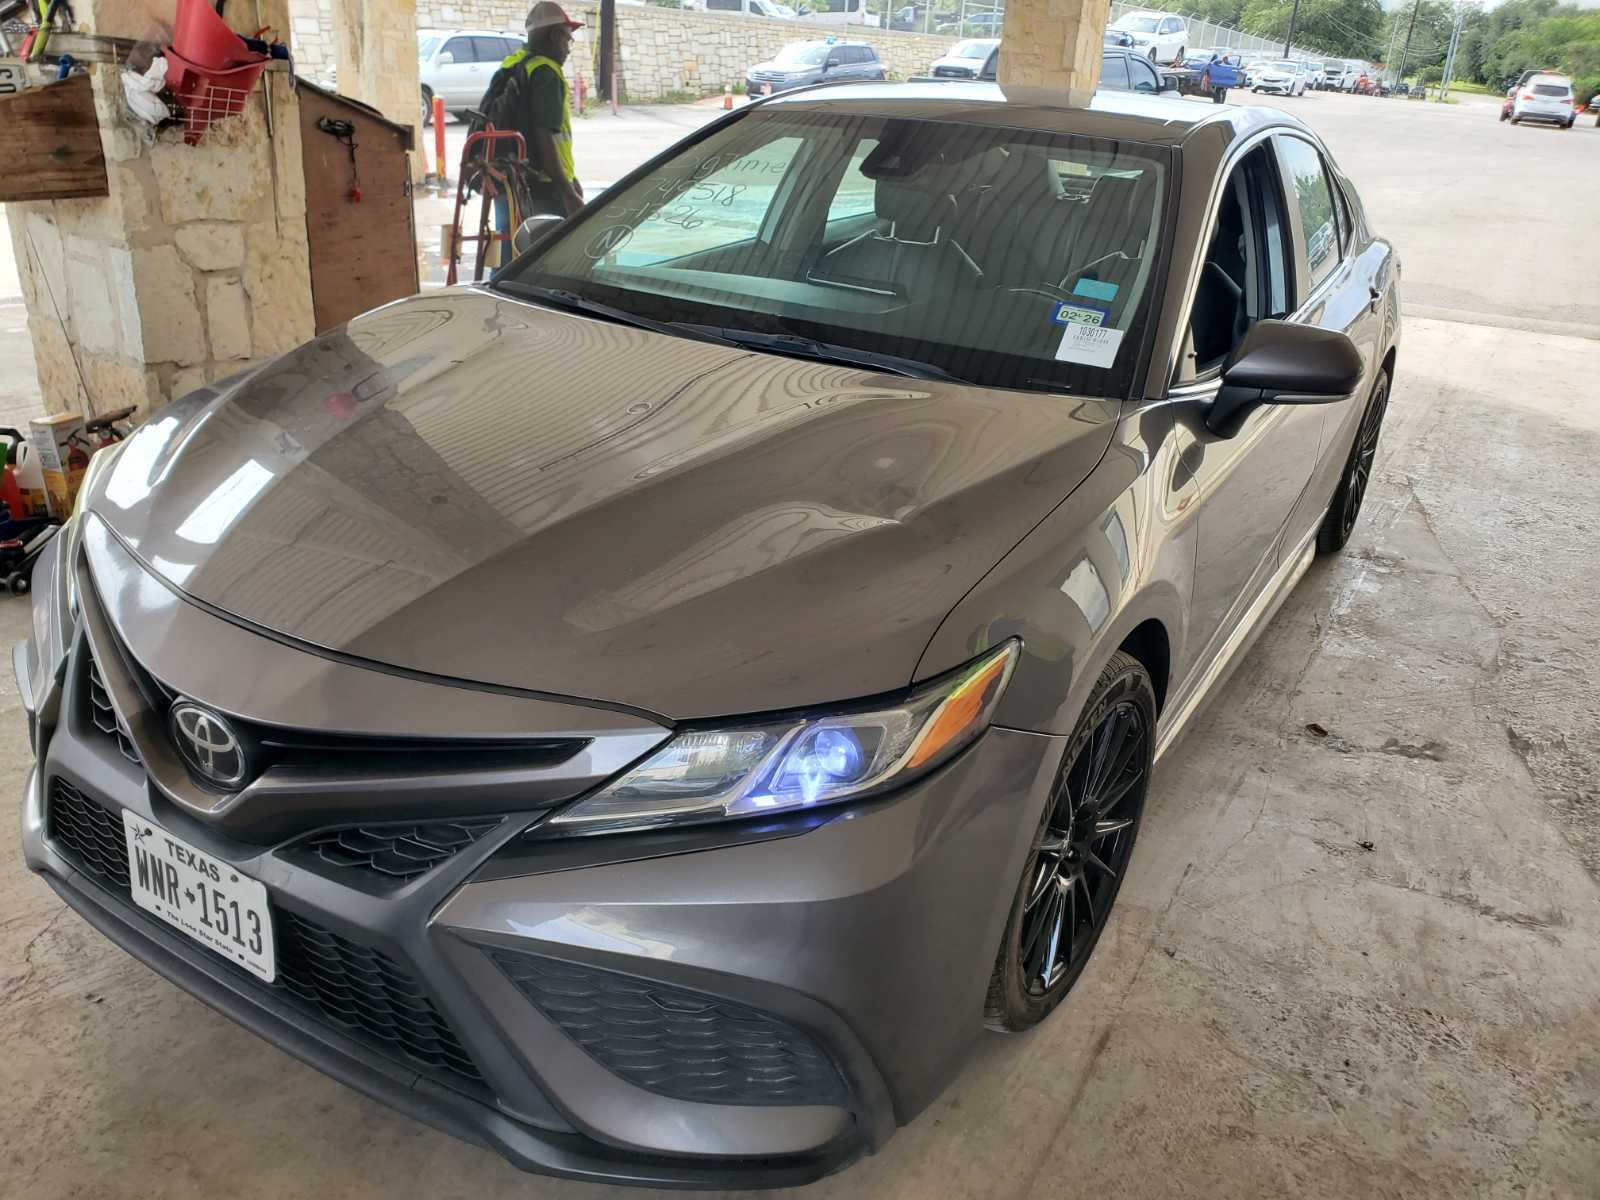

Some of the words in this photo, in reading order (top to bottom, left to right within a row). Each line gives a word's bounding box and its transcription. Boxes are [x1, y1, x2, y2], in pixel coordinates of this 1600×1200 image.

[163, 837, 221, 883] TEXAS
[134, 844, 181, 910] WNR
[196, 881, 263, 956] 1513
